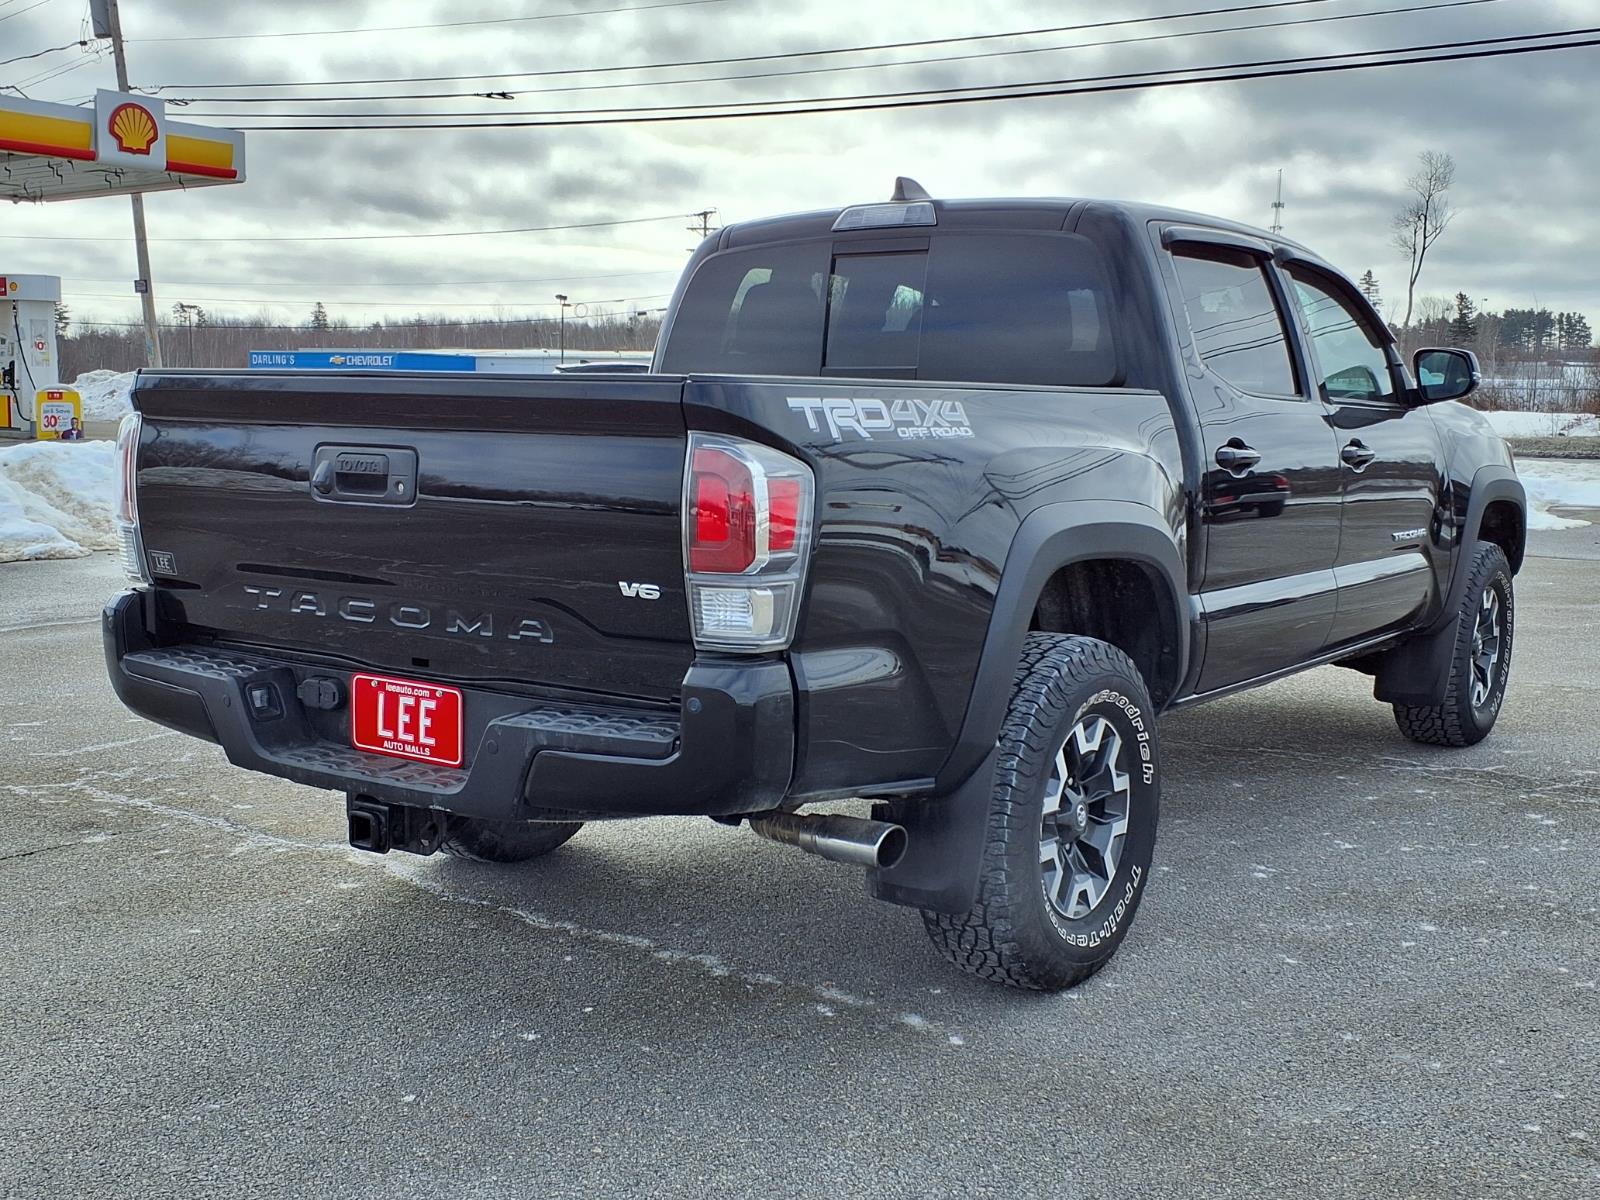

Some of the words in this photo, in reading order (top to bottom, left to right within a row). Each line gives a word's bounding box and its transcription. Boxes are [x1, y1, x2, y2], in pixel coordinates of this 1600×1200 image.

[252, 354, 295, 365] DARLING'S
[346, 355, 393, 366] CHEVROLET
[786, 397, 895, 441] TRD
[897, 427, 929, 438] OFF
[930, 427, 975, 438] ROAD
[338, 459, 382, 472] TOYOTA
[1391, 528, 1427, 542] TACOMA
[155, 556, 171, 569] LEE
[618, 580, 661, 600] V6
[242, 585, 555, 644] TACOMA
[385, 682, 430, 697] leeauto.com
[377, 691, 437, 747] LEE
[383, 740, 404, 751] AUTO
[404, 744, 431, 756] MALLS
